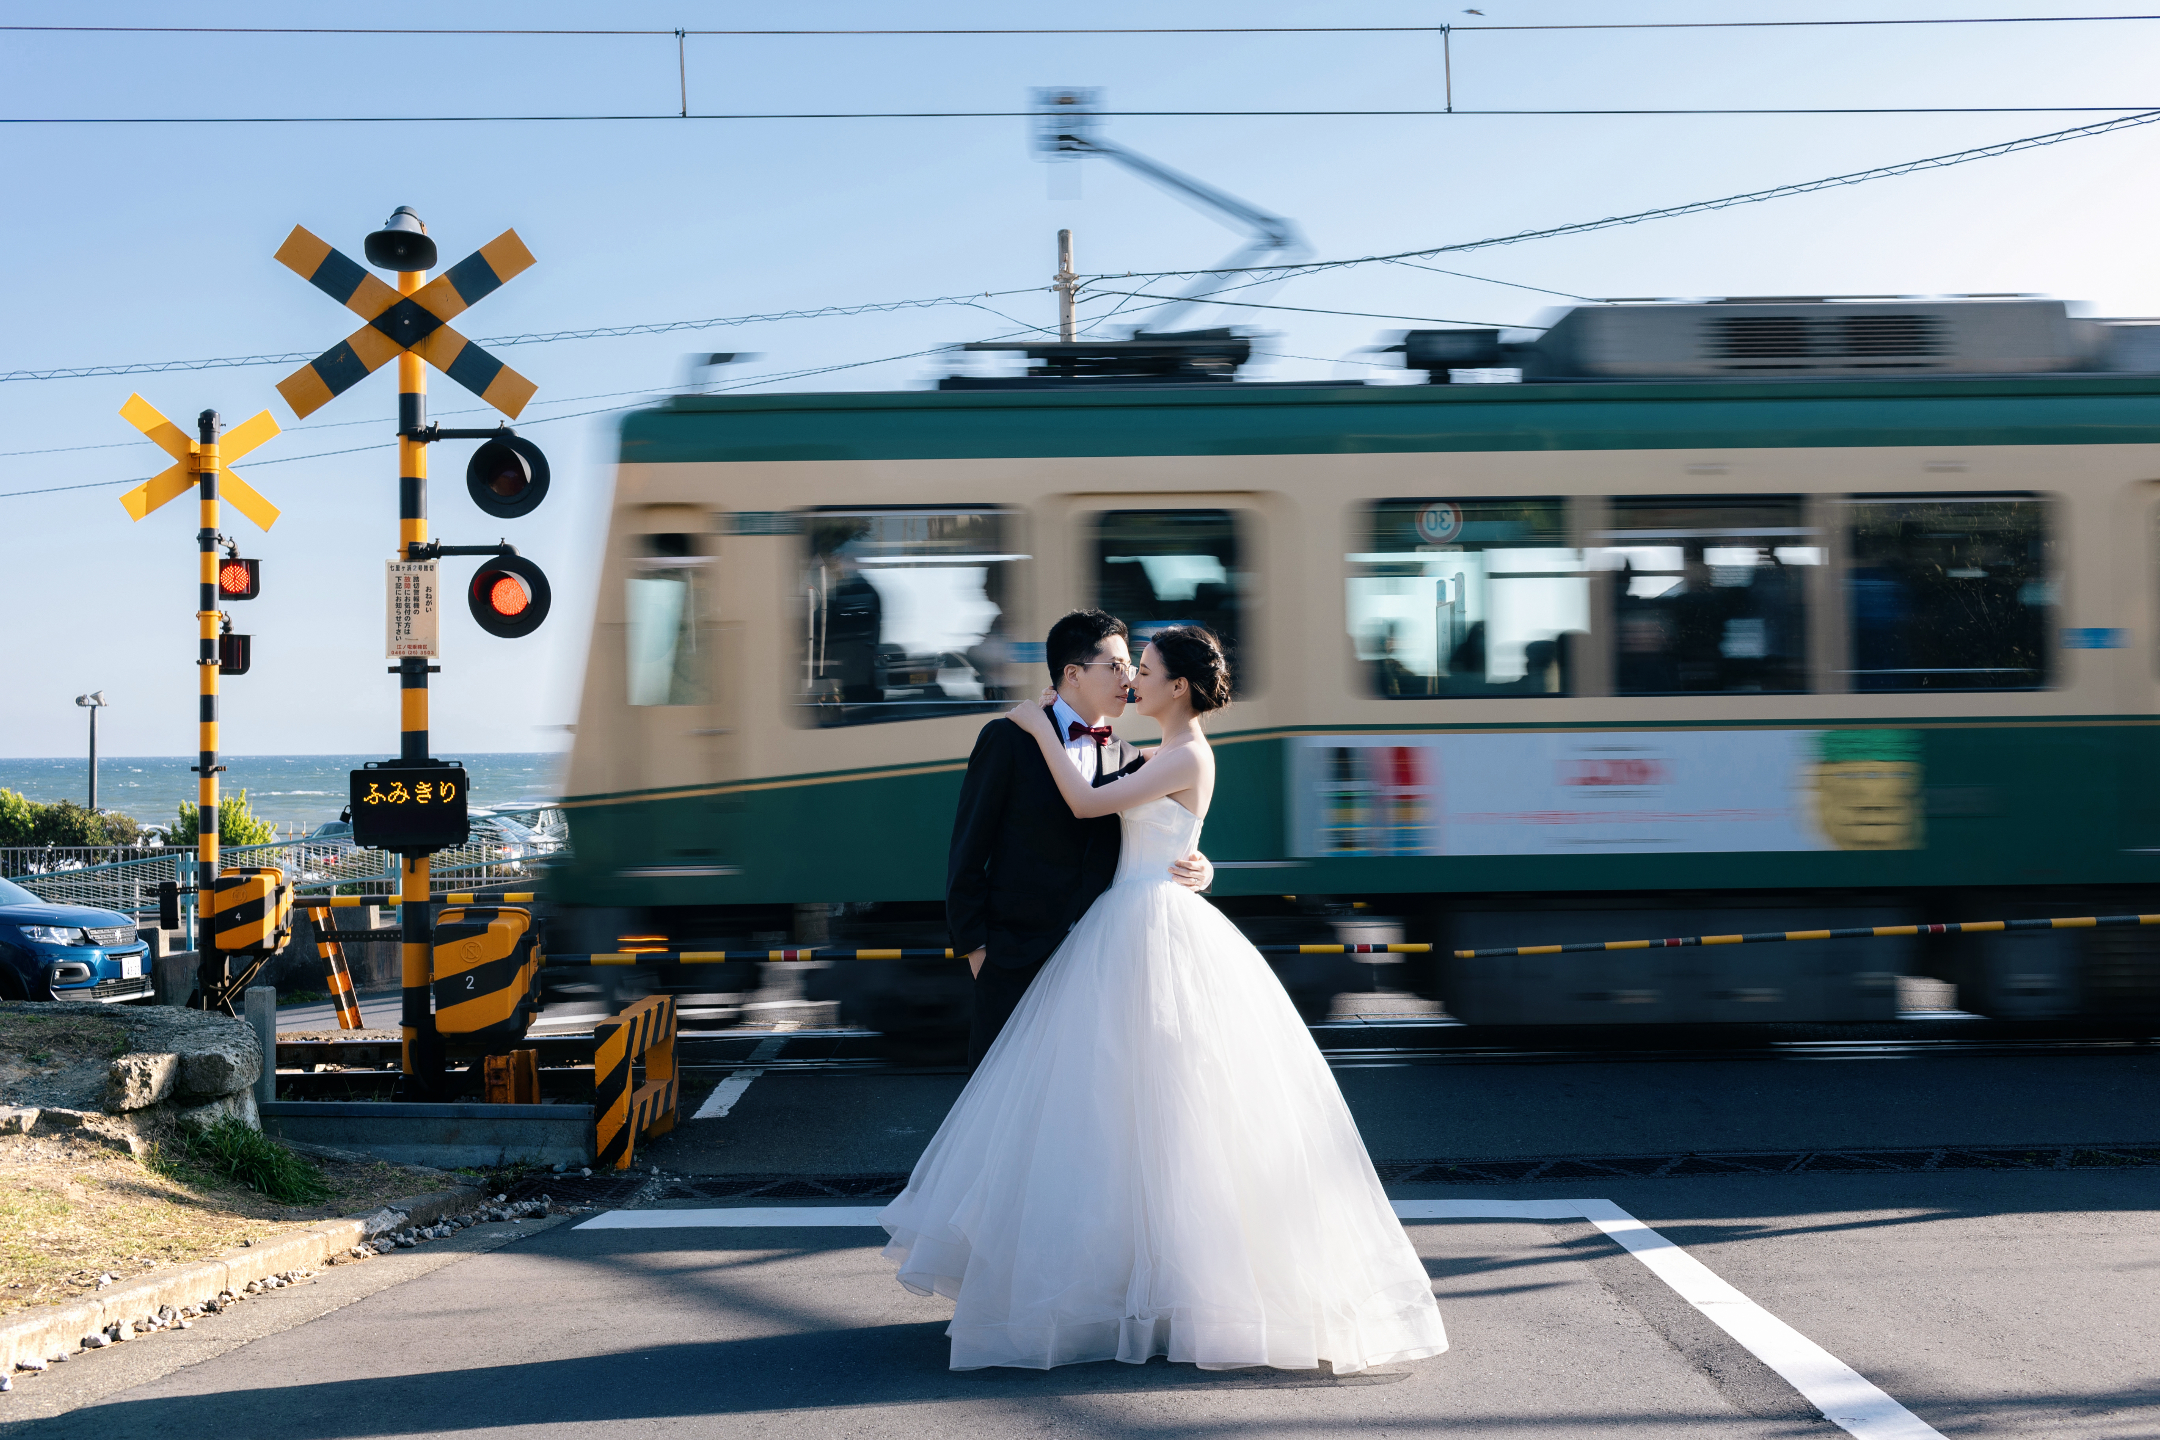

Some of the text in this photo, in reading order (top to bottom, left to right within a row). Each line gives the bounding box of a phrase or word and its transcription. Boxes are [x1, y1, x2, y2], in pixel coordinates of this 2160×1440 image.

[363, 781, 456, 804] ふみきり
[235, 912, 241, 921] 4
[466, 975, 474, 989] 2
